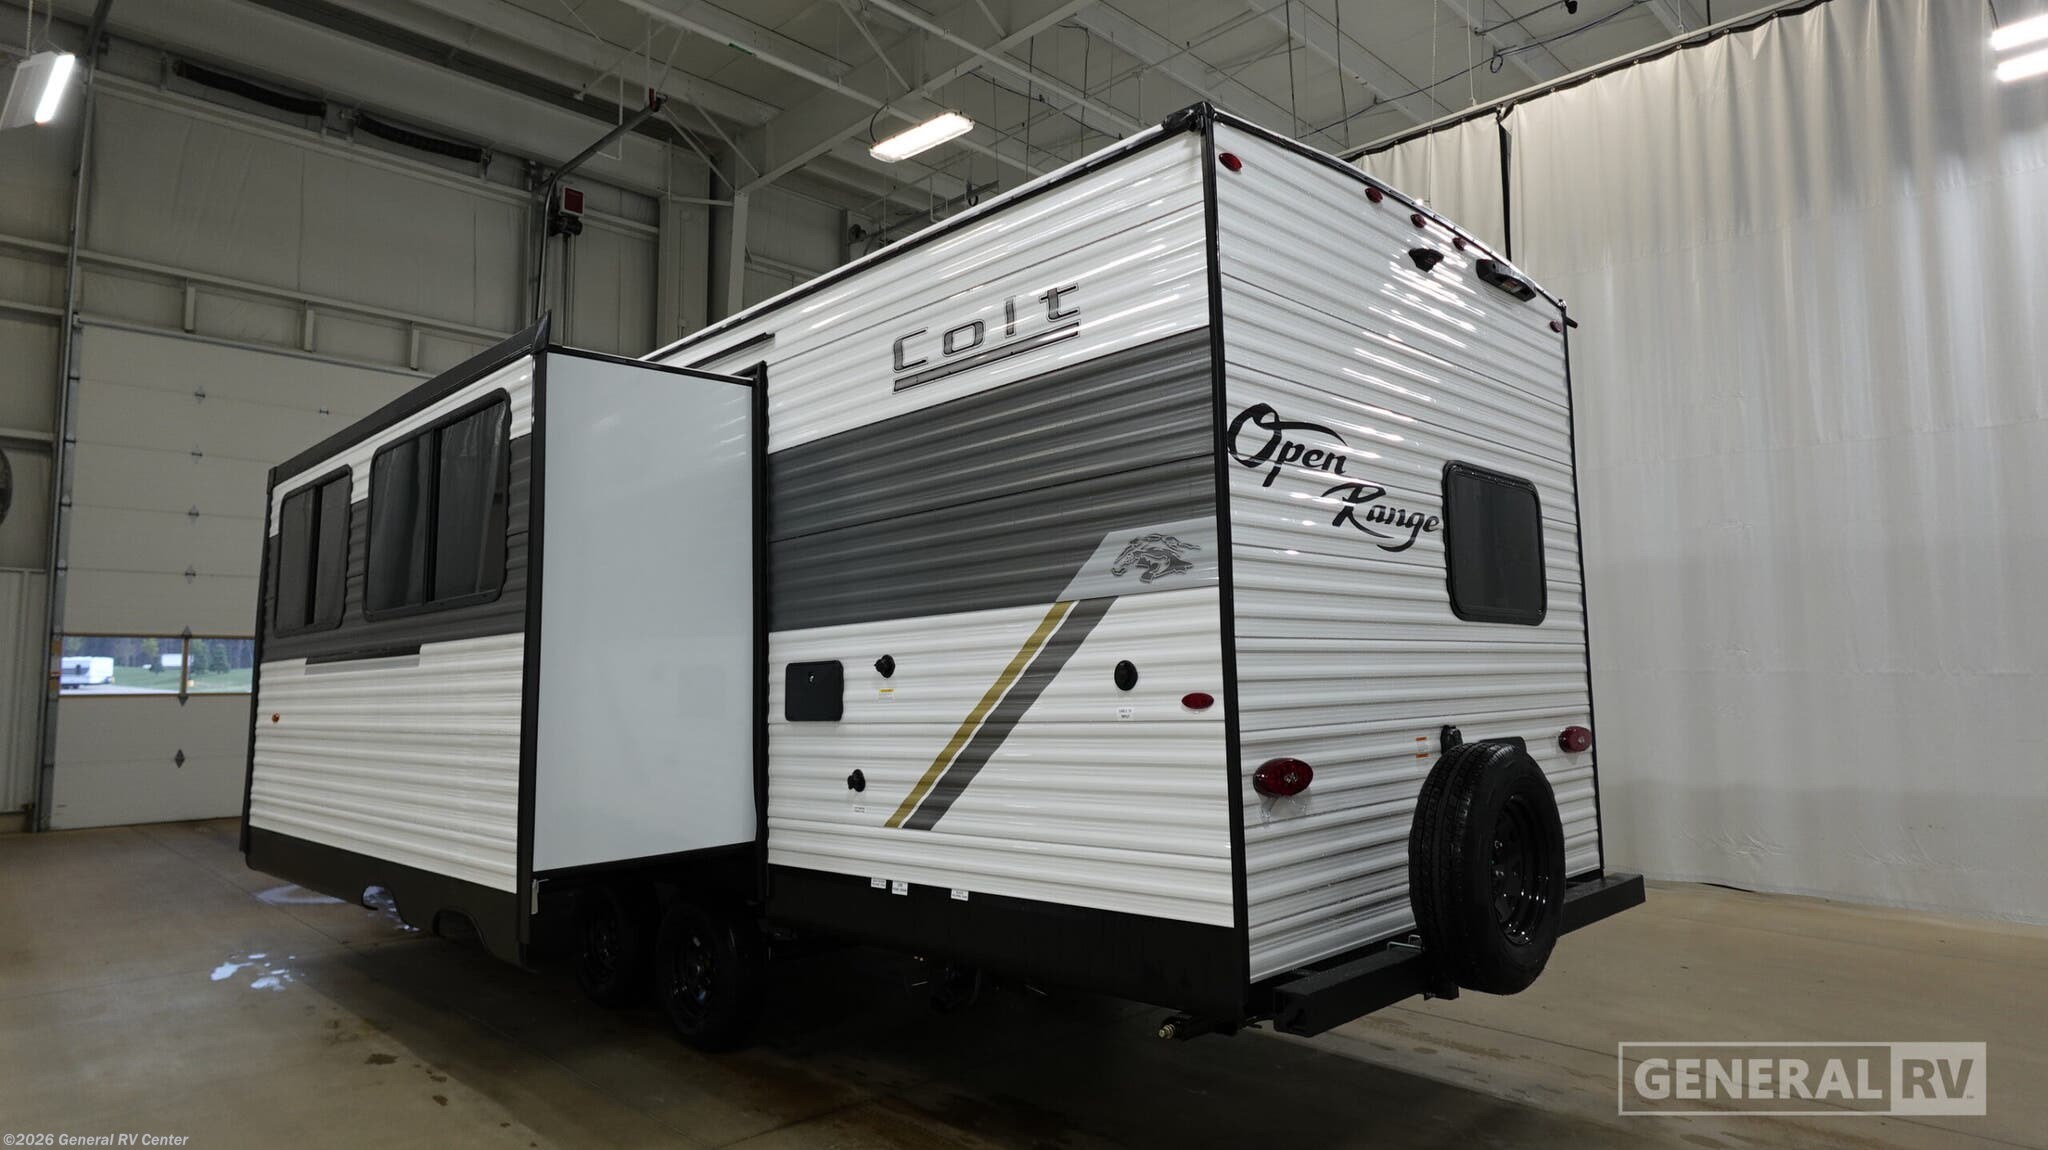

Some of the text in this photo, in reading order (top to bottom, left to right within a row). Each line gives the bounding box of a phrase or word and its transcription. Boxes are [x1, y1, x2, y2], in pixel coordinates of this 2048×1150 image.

[893, 281, 1080, 373] Colt
[1227, 403, 1349, 487] Open
[1320, 482, 1440, 552] Range
